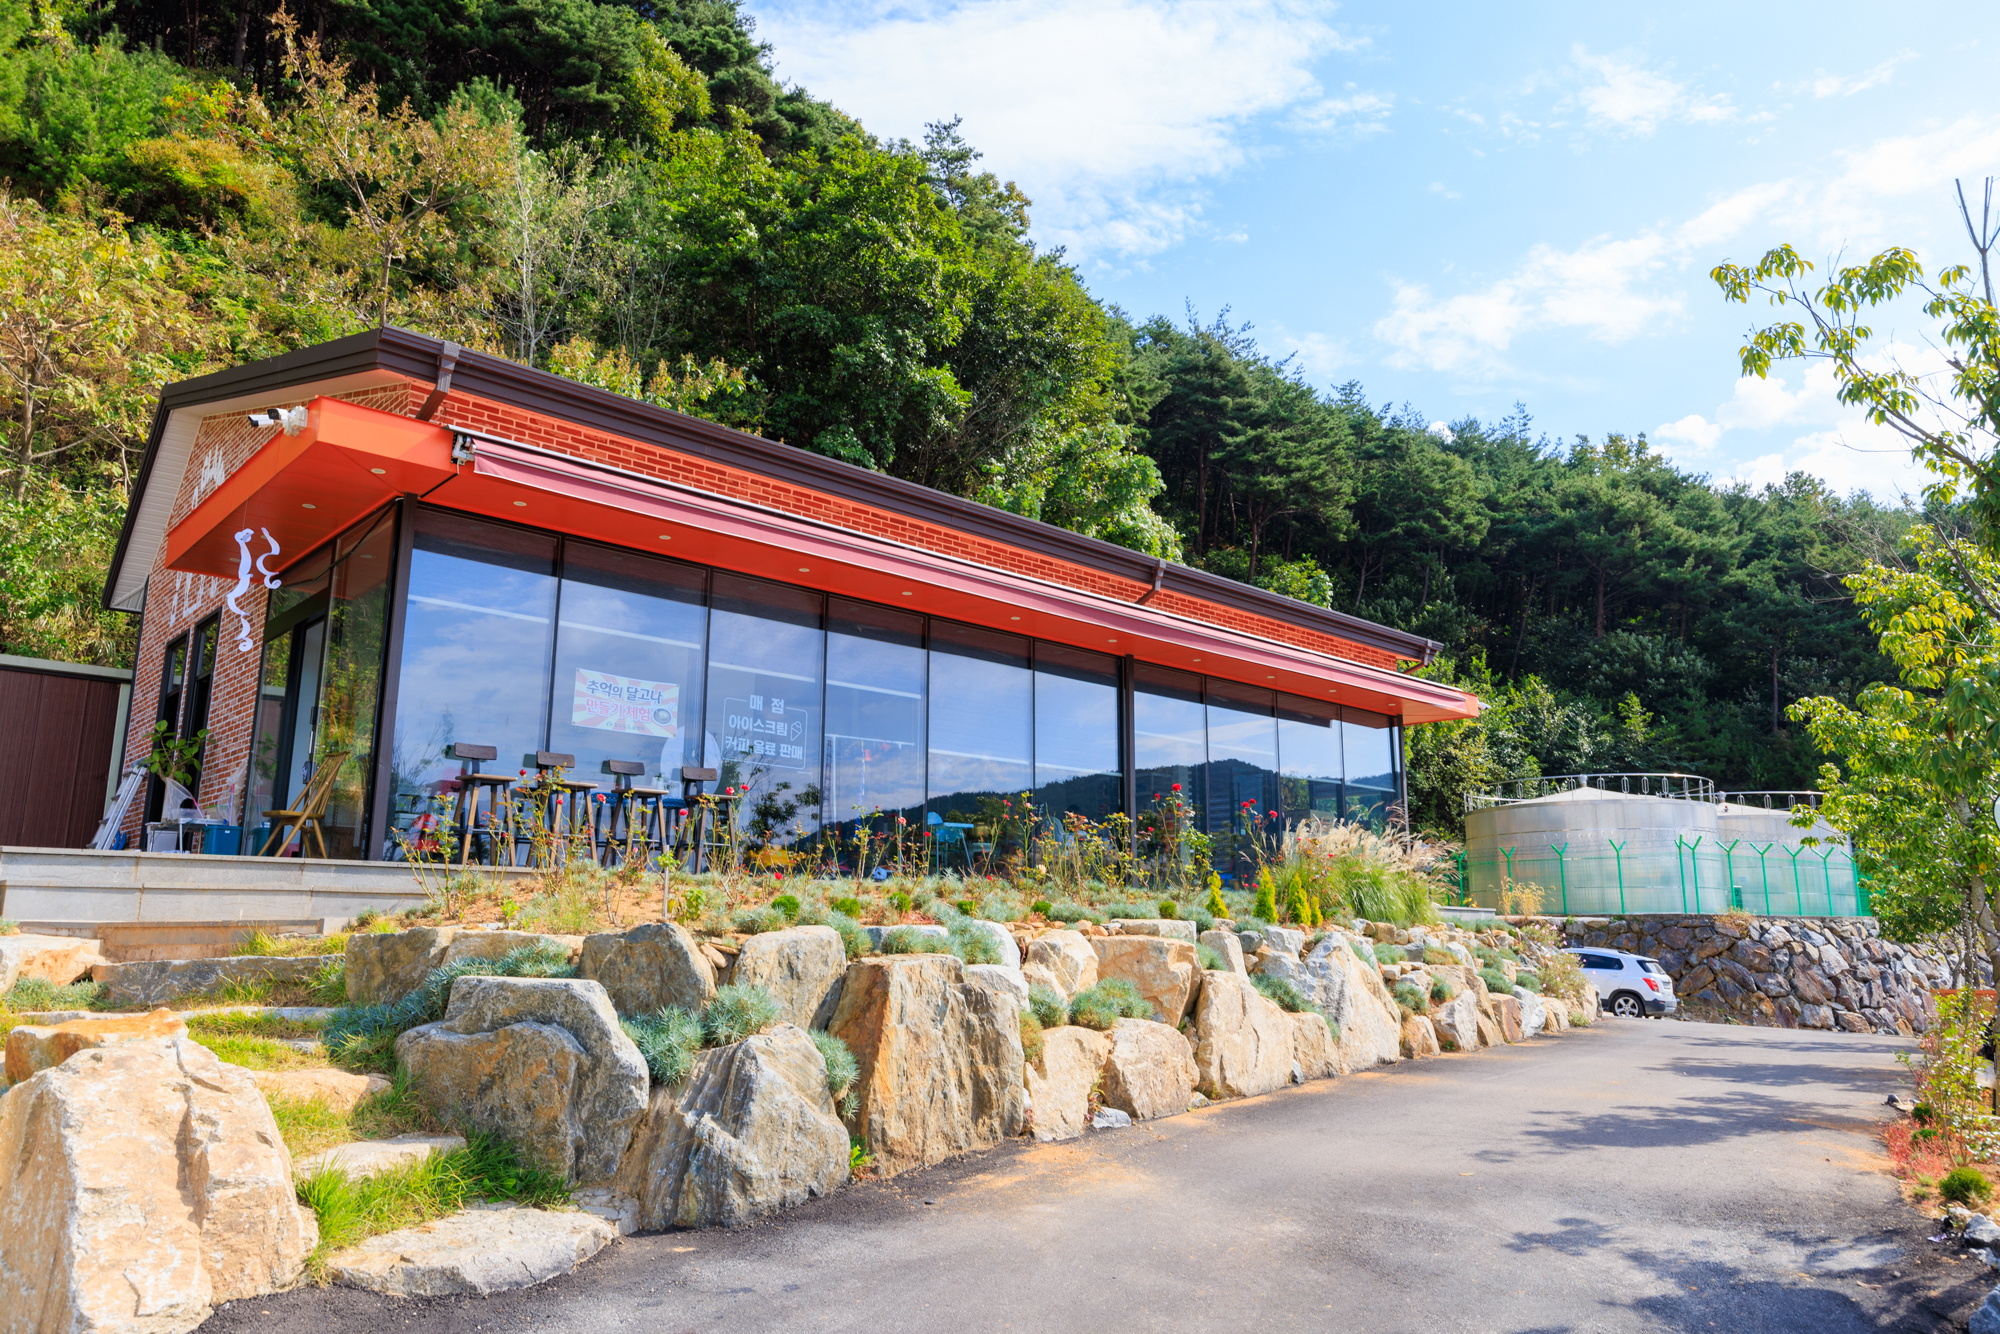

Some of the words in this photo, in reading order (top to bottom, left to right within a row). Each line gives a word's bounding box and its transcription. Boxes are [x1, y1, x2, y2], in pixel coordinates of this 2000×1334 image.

[586, 679, 623, 699] 추억의
[626, 685, 663, 705] 달고나
[586, 698, 623, 718] 만들기
[625, 705, 651, 722] 체험
[728, 714, 788, 737] 아이스크림
[780, 743, 803, 760] 판매
